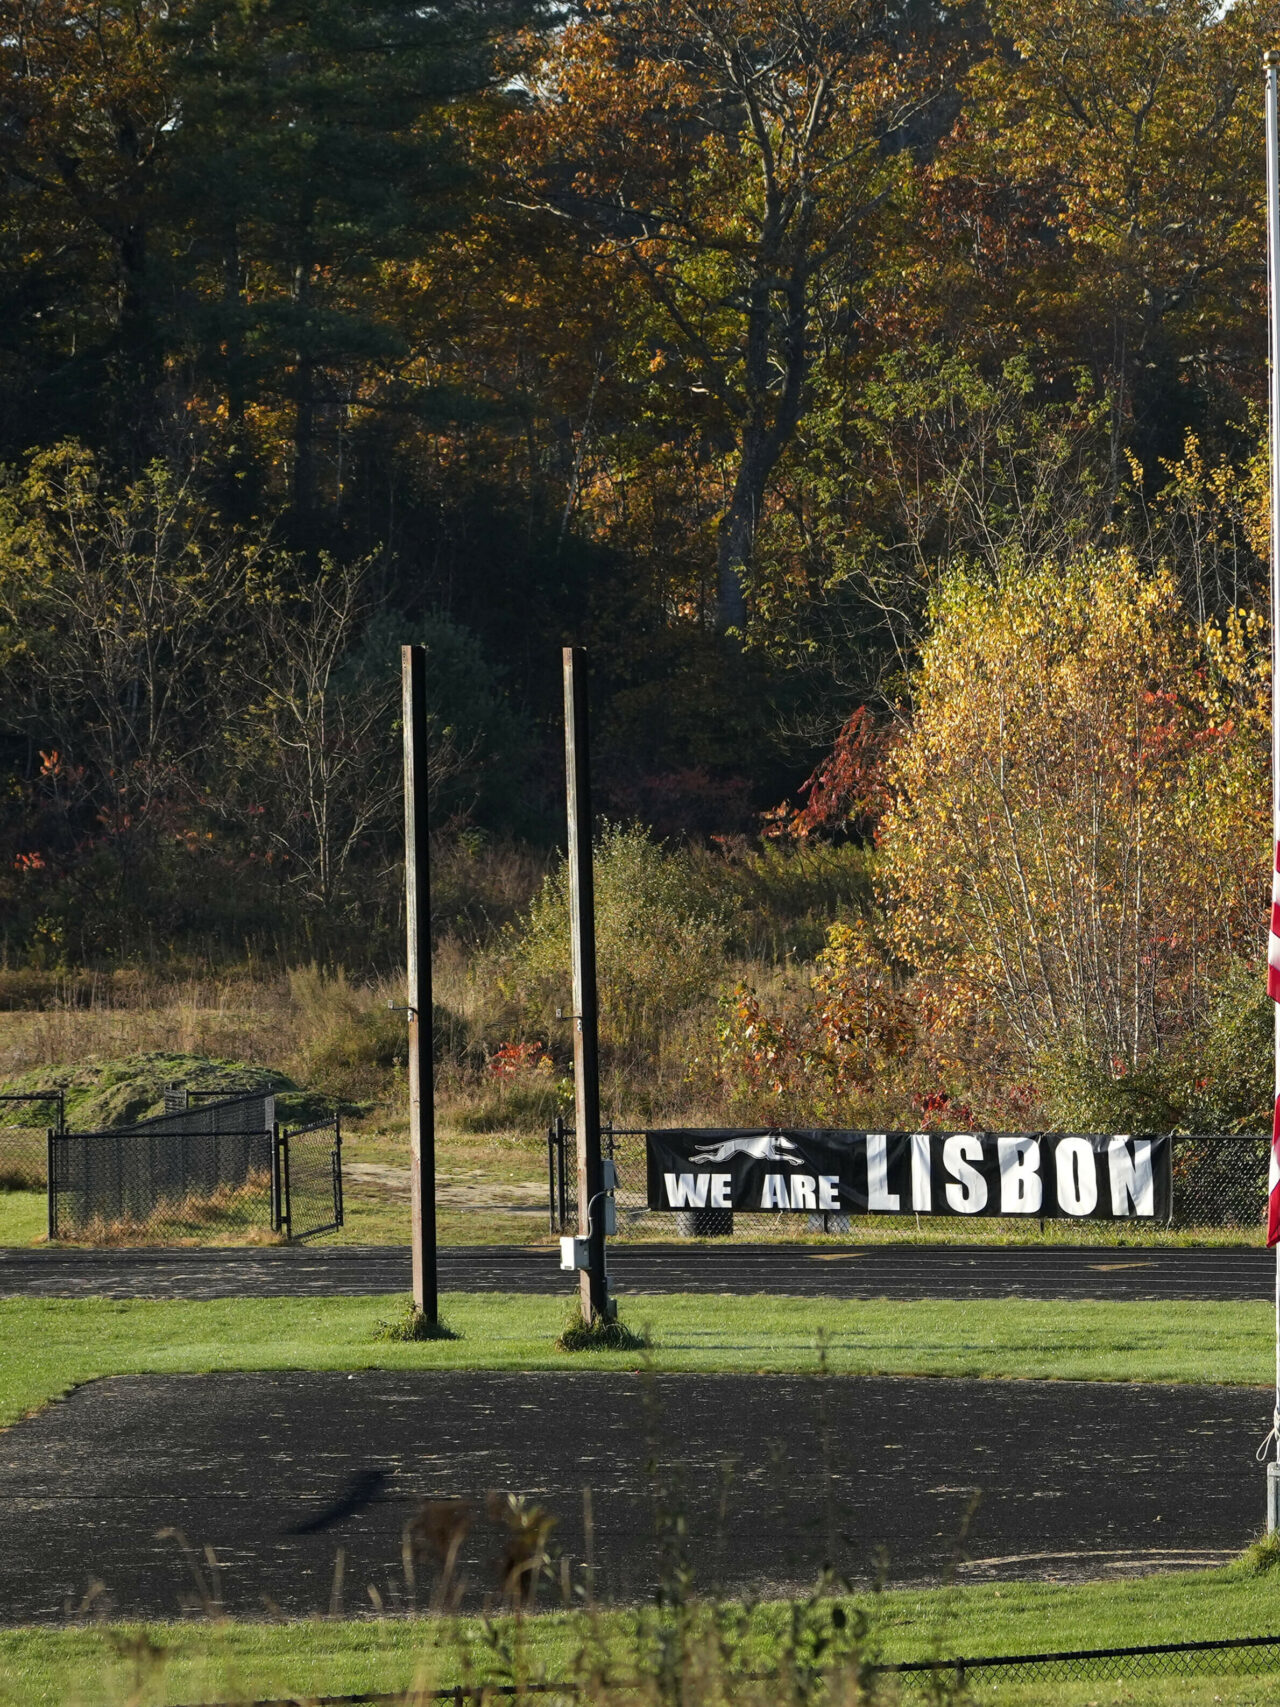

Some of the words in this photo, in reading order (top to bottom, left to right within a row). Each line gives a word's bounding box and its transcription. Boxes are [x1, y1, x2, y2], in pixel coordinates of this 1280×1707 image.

[664, 1173, 732, 1209] WE
[761, 1174, 841, 1210] ARE
[865, 1134, 1155, 1217] LISBON
